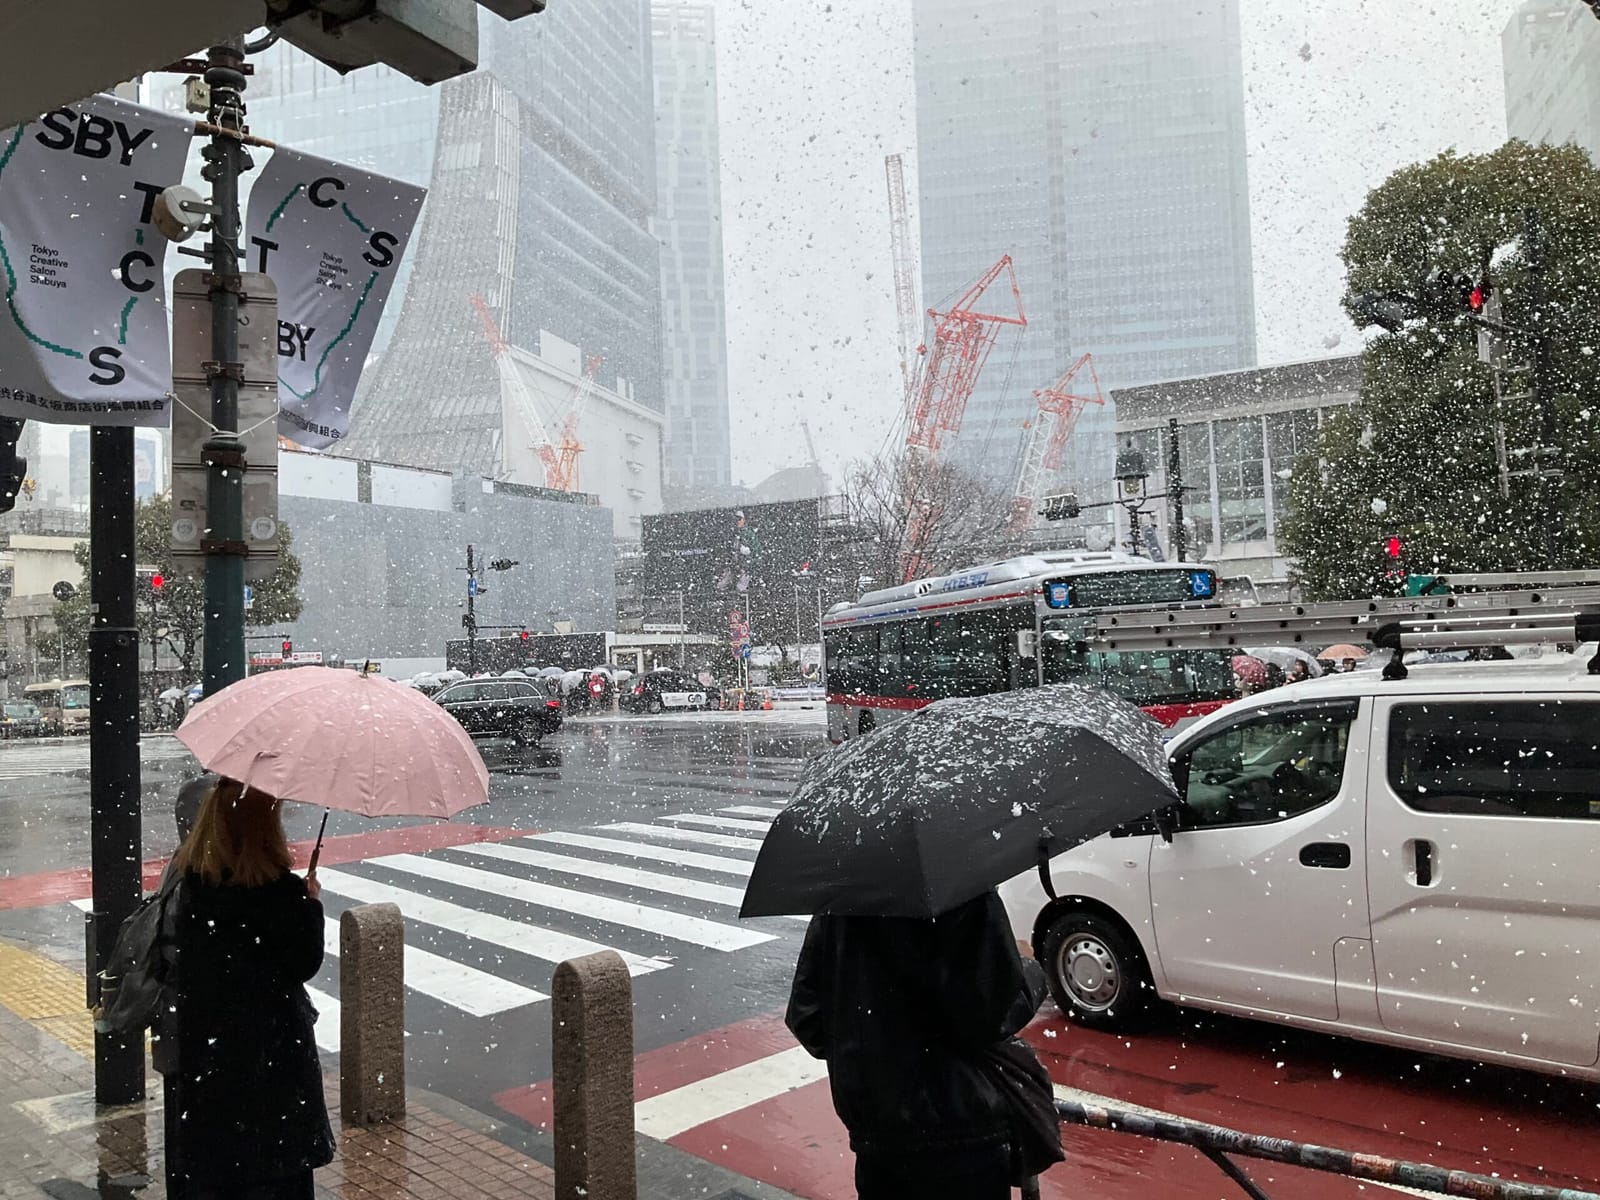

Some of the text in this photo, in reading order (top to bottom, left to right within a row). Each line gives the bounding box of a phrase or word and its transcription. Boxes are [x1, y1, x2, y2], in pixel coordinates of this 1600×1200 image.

[35, 108, 154, 166] SBY
[134, 181, 166, 224] T
[308, 177, 345, 208] C
[30, 255, 68, 268] Creative
[31, 244, 59, 256] Tokyo
[251, 236, 279, 273] T
[363, 231, 399, 268] S
[30, 265, 56, 276] Salon
[30, 275, 67, 288] Shibuya
[120, 251, 155, 292] C
[277, 320, 316, 361] BY
[89, 346, 125, 385] S
